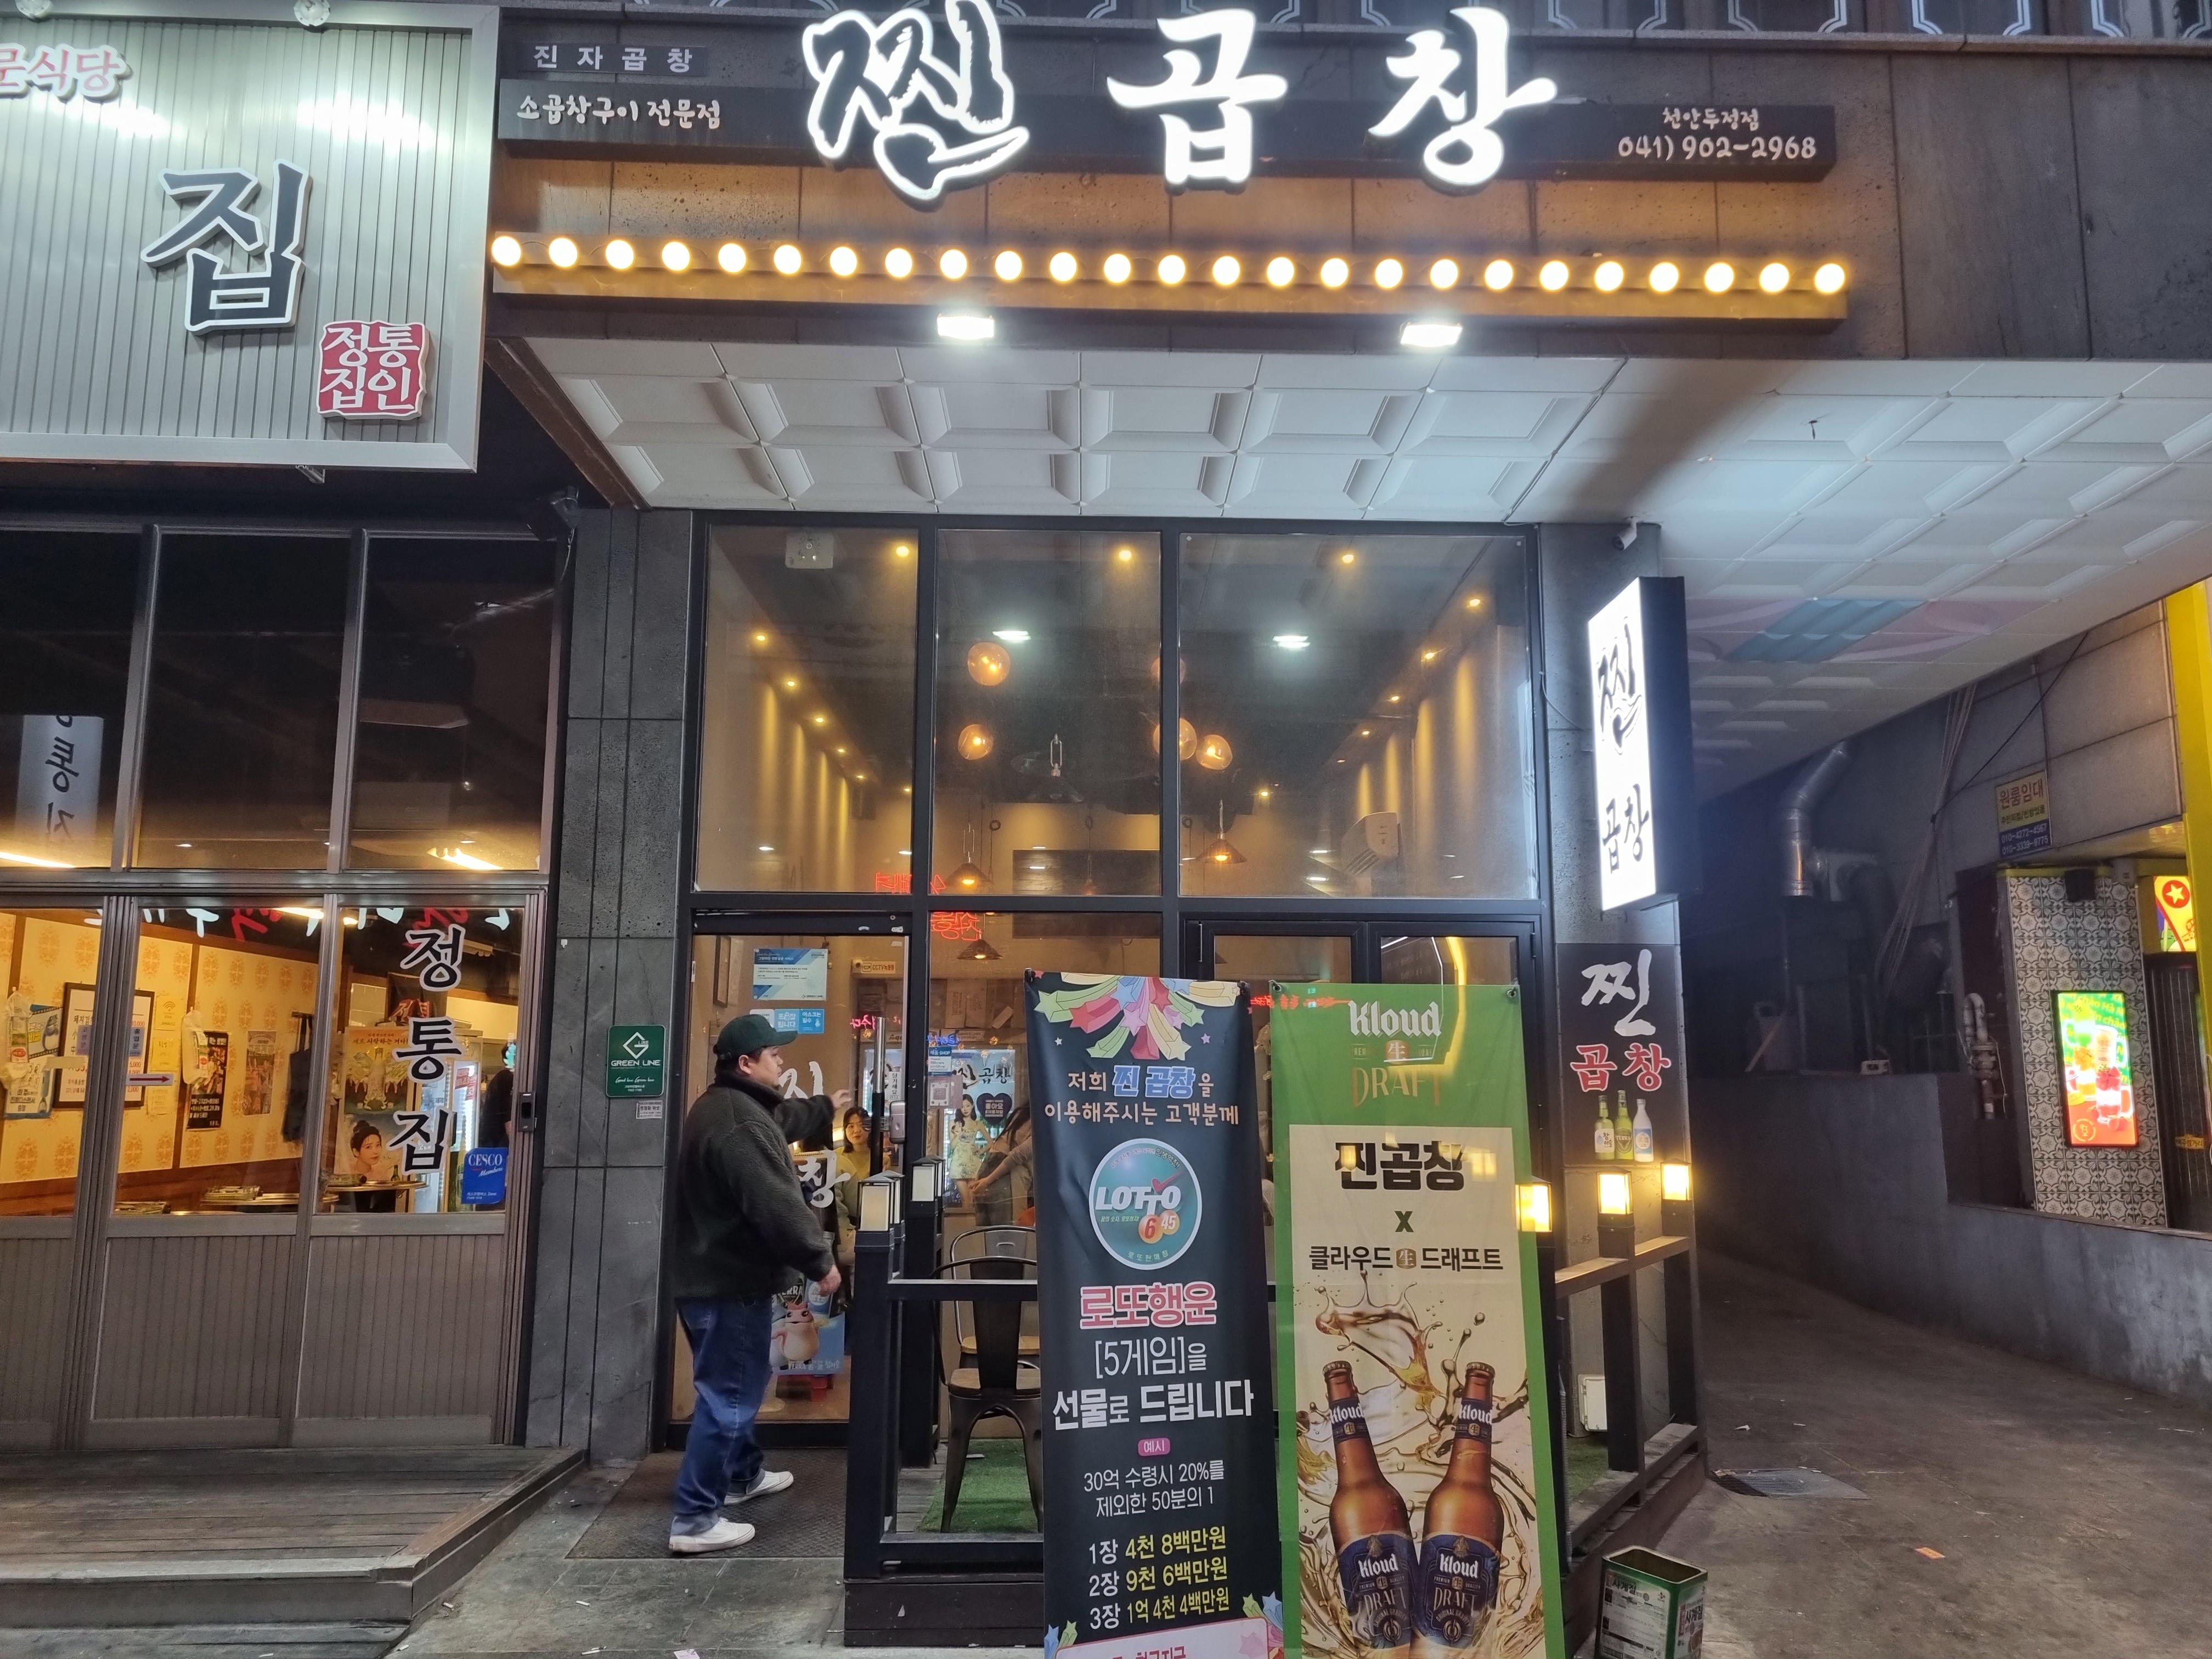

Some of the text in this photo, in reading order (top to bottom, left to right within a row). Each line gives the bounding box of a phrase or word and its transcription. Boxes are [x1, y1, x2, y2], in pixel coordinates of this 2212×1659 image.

[517, 94, 721, 130] 소곱창구이 전문점
[1662, 108, 1759, 131] 천안두정점
[1618, 134, 1816, 161] 041) 902-2968
[140, 158, 311, 332] 집
[1595, 616, 1642, 755] 찐
[2000, 778, 2044, 810] 원룸임대
[1602, 783, 1650, 874] 곱창
[1581, 949, 1656, 1037] 찐
[1348, 1000, 1442, 1037] Kloud
[387, 924, 466, 1176] 정통집
[1068, 1072, 1106, 1092] 저희
[1113, 1065, 1141, 1097] 찐
[1570, 1042, 1672, 1092] 곱창
[1351, 1066, 1441, 1108] DRAFT
[1045, 1100, 1239, 1126] 이용해주시는 고객분께
[468, 1153, 503, 1166] CESCO
[1096, 1185, 1182, 1215] LOTTO
[1144, 1218, 1156, 1239] 6
[1161, 1215, 1177, 1230] 45
[1309, 1246, 1393, 1271] 클라우드
[1420, 1248, 1503, 1272] 드래프트
[1080, 1281, 1217, 1330] 로또행운
[1096, 1336, 1207, 1379] [5게임]을
[1053, 1380, 1254, 1431] 선물로 드립니다
[1330, 1403, 1364, 1424] Kloud
[1459, 1404, 1493, 1425] Kloud
[1143, 1440, 1165, 1453] 예시
[1084, 1460, 1224, 1492] 30억 수령시 20%를
[1096, 1486, 1214, 1517] 제외한 50분의 1
[1089, 1526, 1227, 1565] 1장 4천 8백만원
[1089, 1556, 1228, 1597] 2장 9천 6백만원
[1358, 1553, 1398, 1578] Kloud
[1440, 1553, 1479, 1579] Kloud
[1090, 1587, 1230, 1630] 3장 1억 4천 4백만원
[1364, 1587, 1407, 1622] DRAFT
[1433, 1587, 1478, 1617] DRAFT
